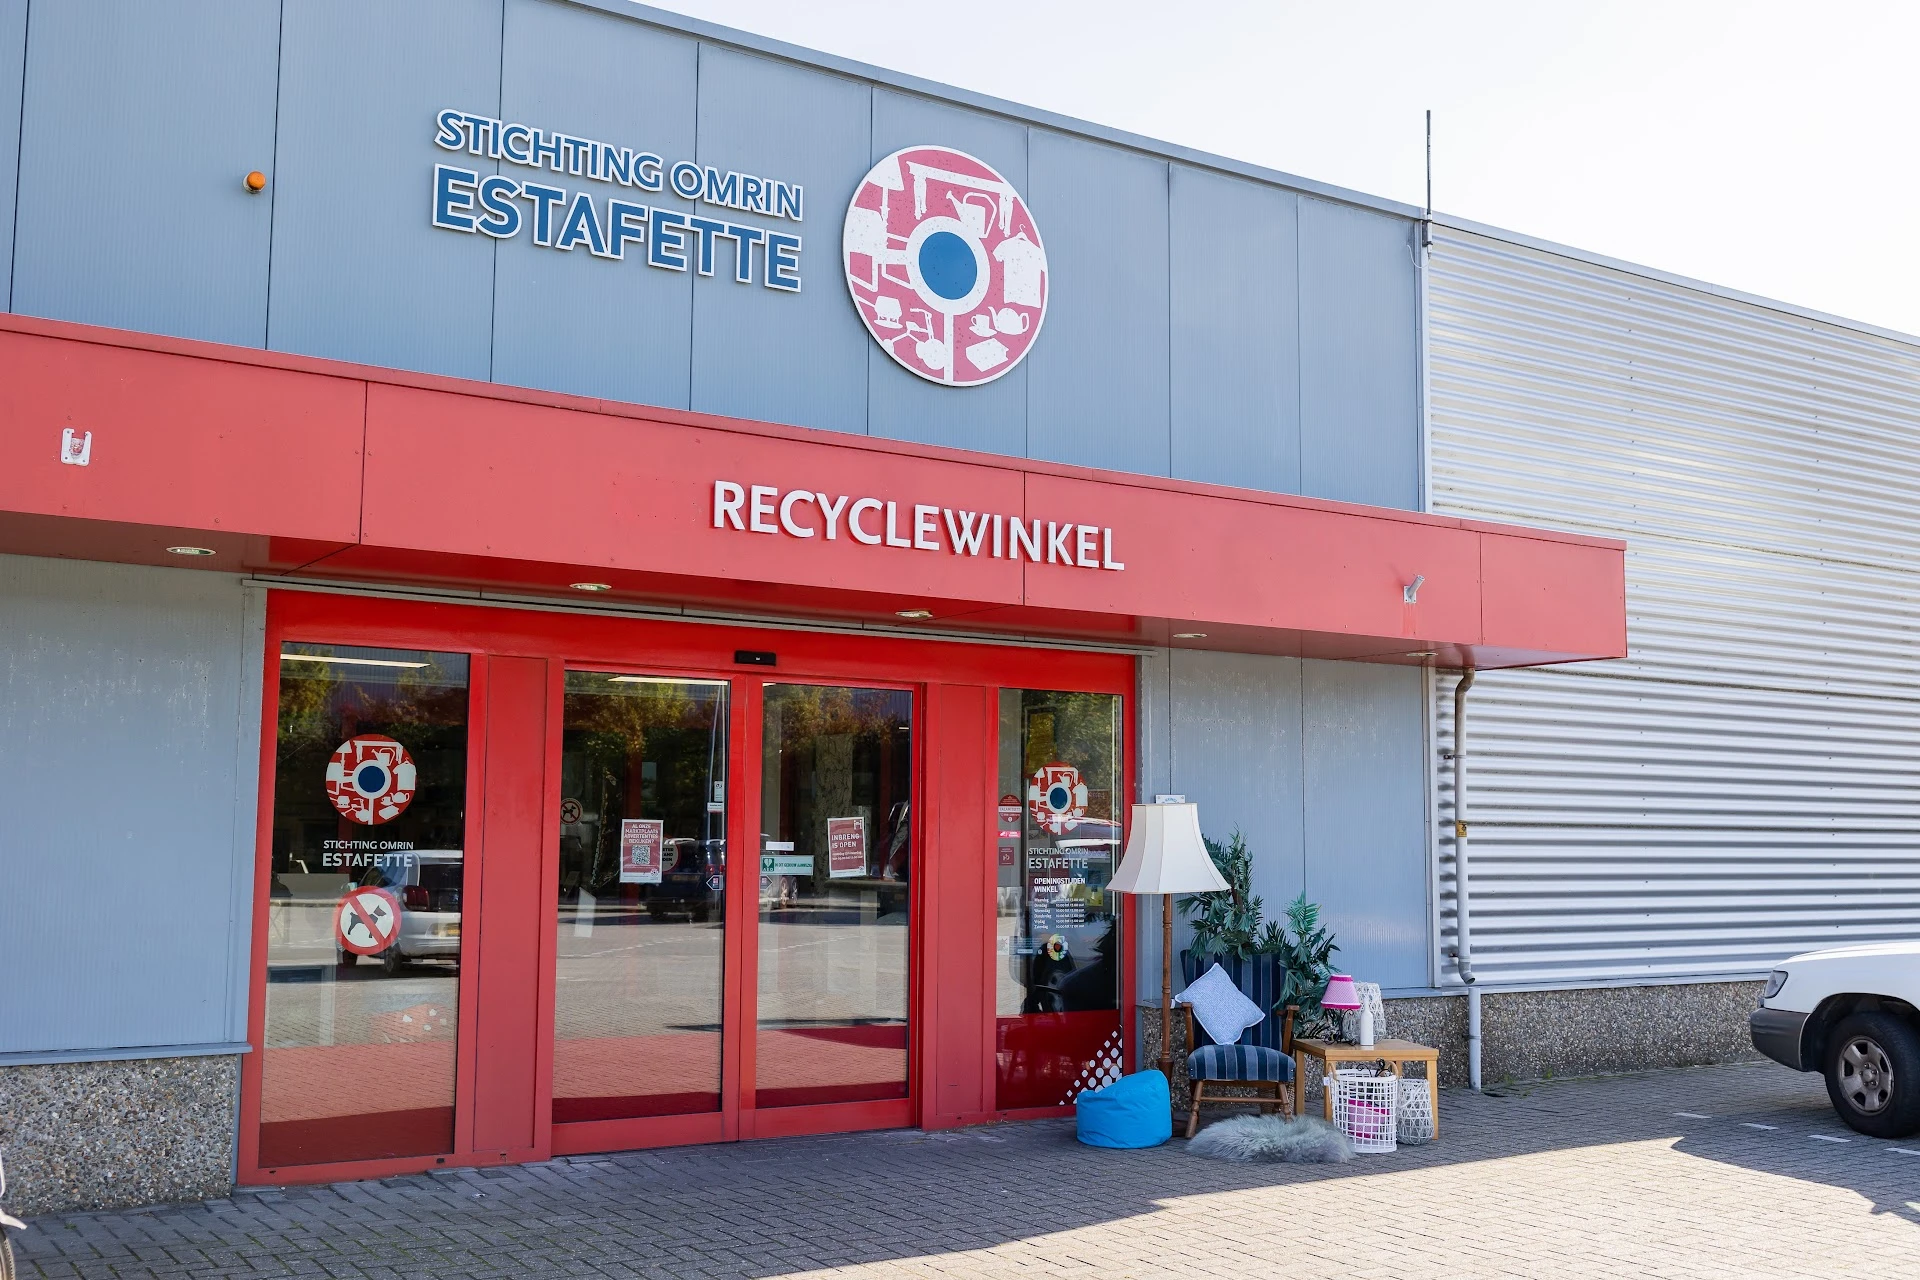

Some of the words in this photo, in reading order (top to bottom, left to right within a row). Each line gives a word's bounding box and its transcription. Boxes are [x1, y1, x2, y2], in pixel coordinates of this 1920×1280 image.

[434, 107, 662, 192] STICHTING
[669, 160, 804, 222] OMRIN
[431, 162, 802, 293] ESTAFETTE
[713, 480, 1125, 571] RECYCLEWINKEL
[831, 833, 860, 841] INBRENG
[323, 839, 378, 850] STICHTING
[379, 840, 414, 850] OMRIN
[1029, 847, 1064, 855] STICHTING
[1065, 847, 1089, 855] OMRIN
[322, 852, 413, 867] ESTAFETTE
[1028, 857, 1089, 869] ESTAFETTE
[1034, 877, 1086, 885] OPENINGSTIJDEN
[1034, 885, 1059, 893] WINKEL
